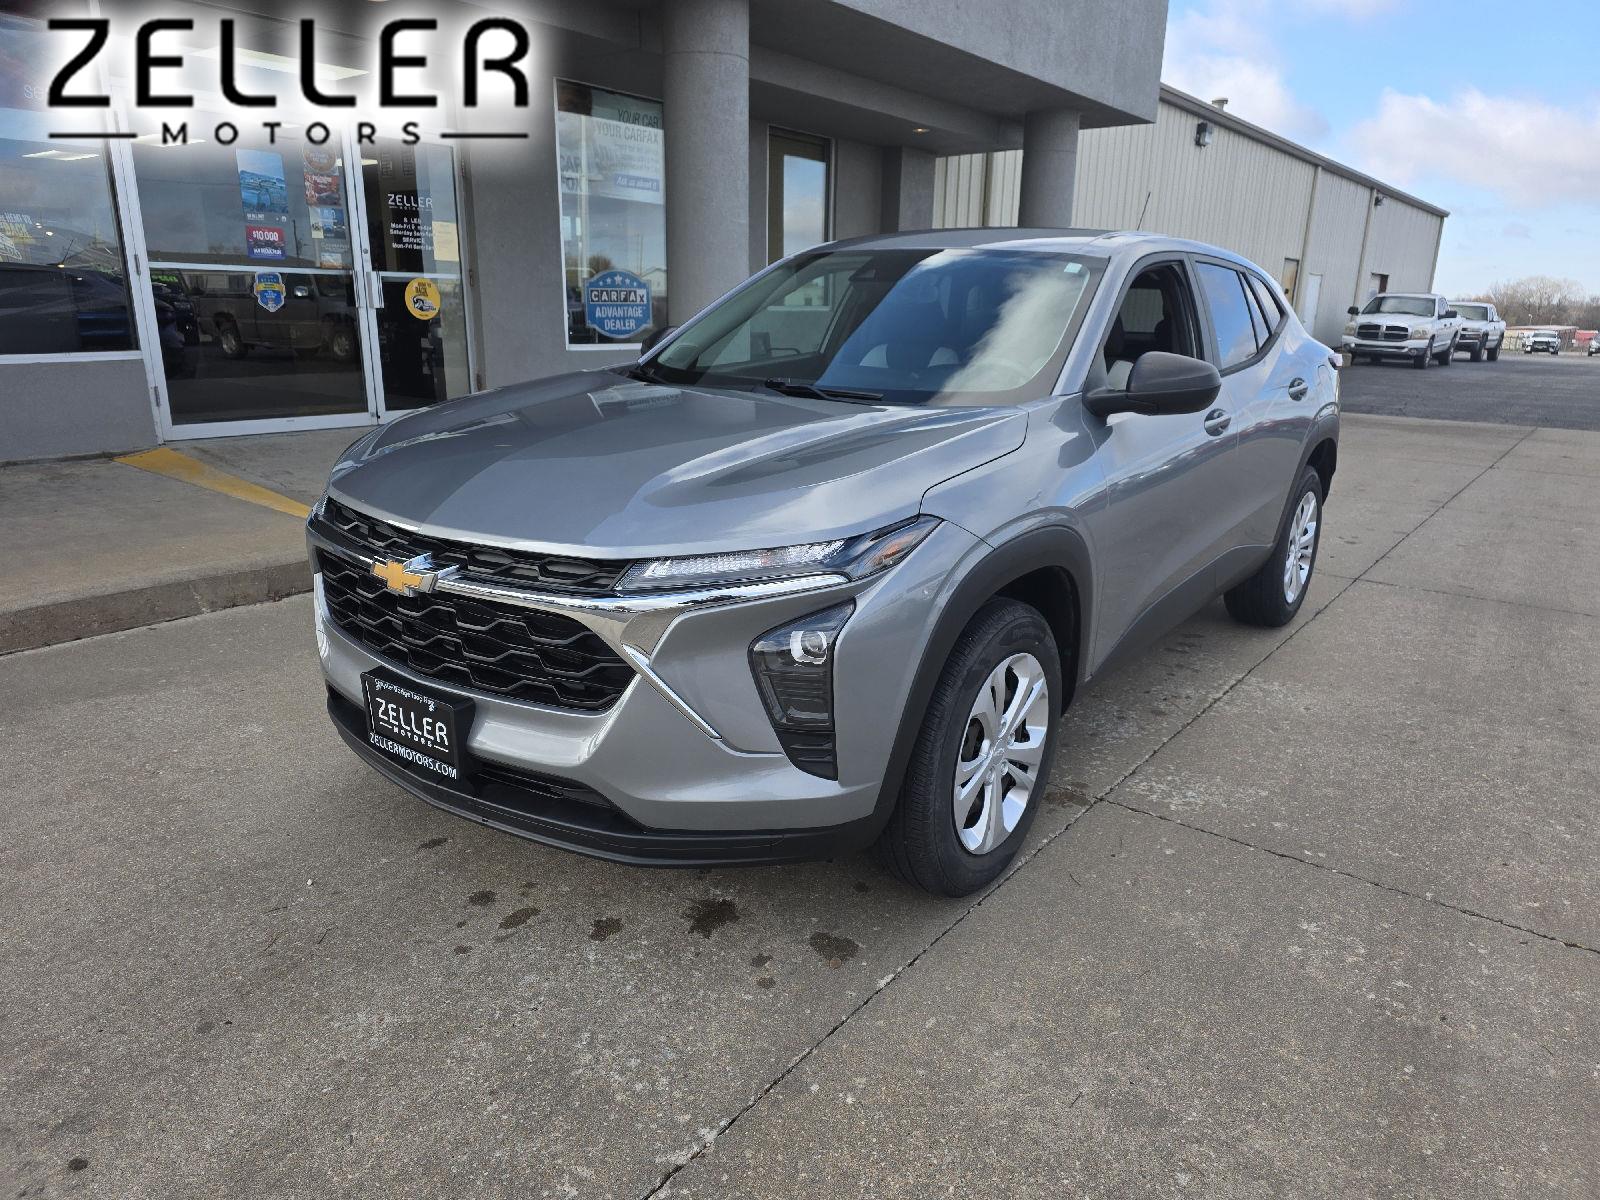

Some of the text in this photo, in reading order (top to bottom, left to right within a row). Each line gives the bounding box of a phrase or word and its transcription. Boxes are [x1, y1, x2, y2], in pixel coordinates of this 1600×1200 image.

[617, 108, 659, 129] YOUR CAR
[595, 121, 659, 144] YOUR CARFAX
[388, 193, 433, 209] ZELLER
[590, 289, 646, 304] CARFAX
[595, 305, 643, 318] ADVANTAGE
[604, 318, 636, 331] DEALER
[376, 697, 449, 746] ZELLER
[370, 732, 457, 780] ZELLERMOTORS.COM
